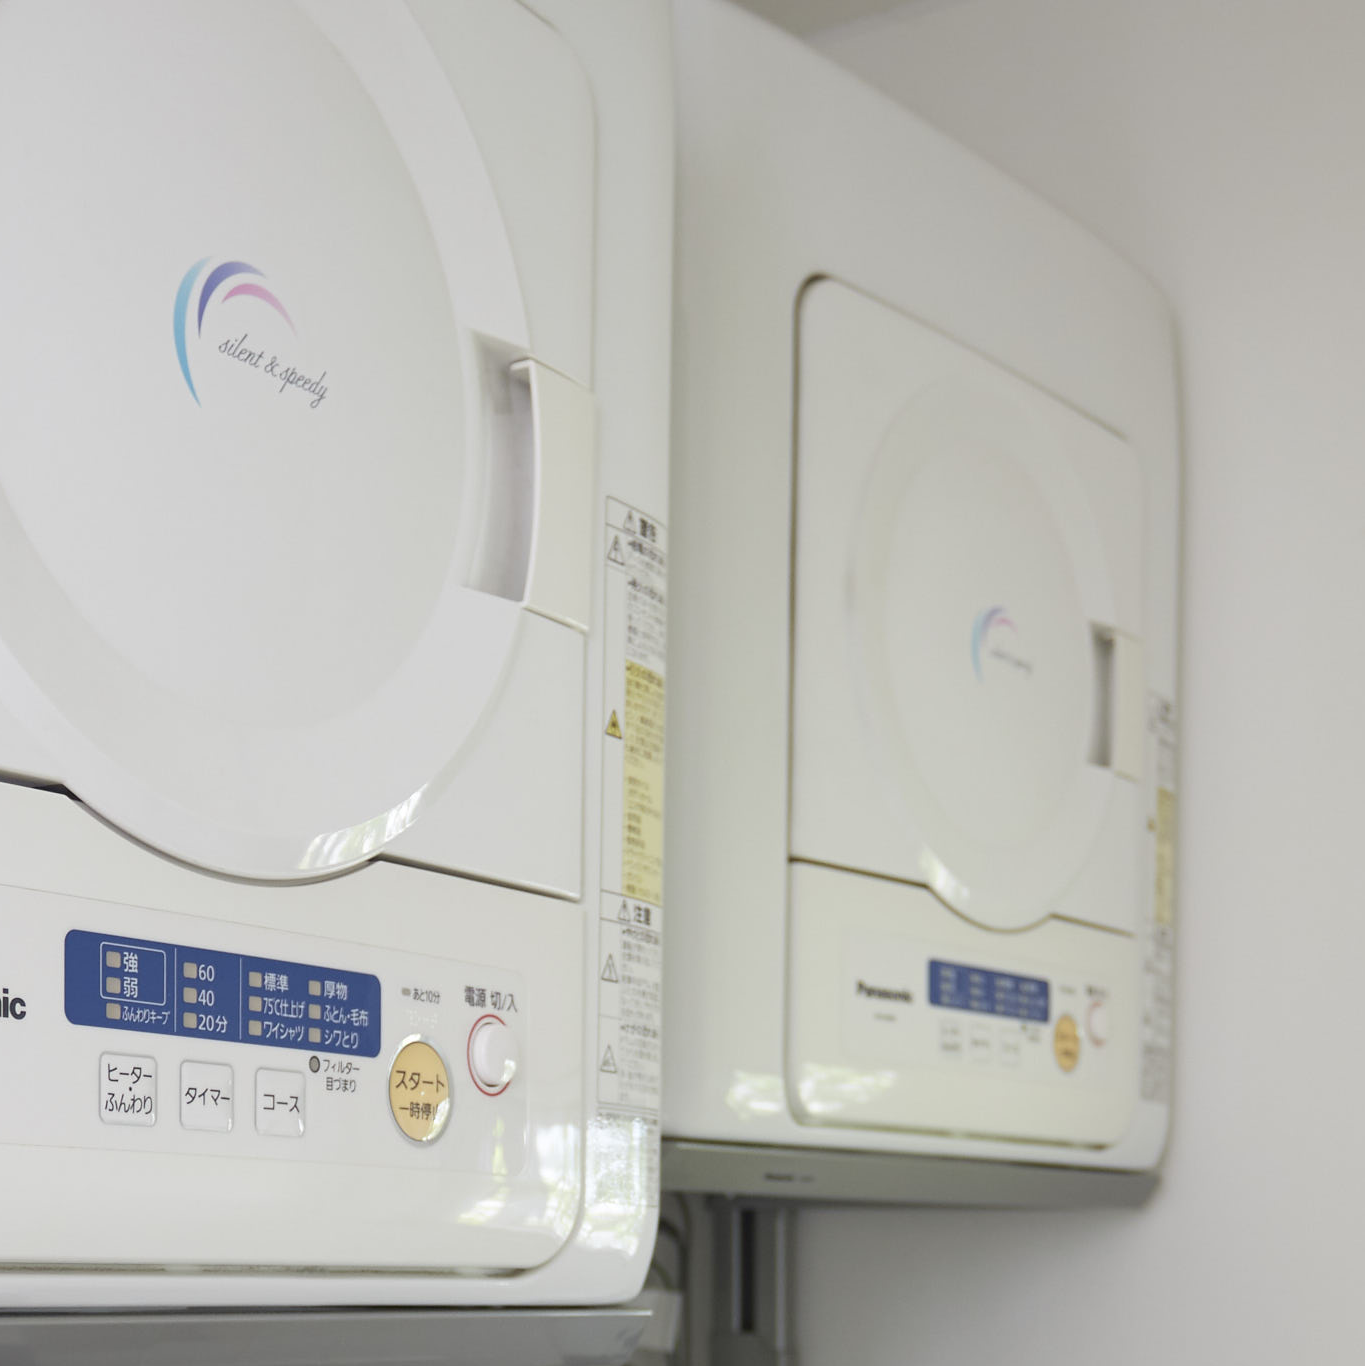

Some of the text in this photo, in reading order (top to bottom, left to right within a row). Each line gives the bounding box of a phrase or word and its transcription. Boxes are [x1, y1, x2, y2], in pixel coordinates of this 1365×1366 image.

[218, 333, 265, 368] silent
[279, 367, 328, 409] speedy
[123, 952, 138, 973] 強
[198, 964, 215, 982] 60
[264, 972, 289, 992] 標準
[123, 977, 138, 998] 弱
[324, 981, 348, 1000] 厚物
[198, 989, 215, 1007] 40
[122, 1005, 171, 1025] ふんわりキープ
[198, 1014, 228, 1033] 20分
[263, 1021, 304, 1041] ワイシャツ
[324, 1029, 359, 1049] シワとり
[107, 1064, 153, 1083] ヒーター
[323, 1059, 360, 1073] フィルター
[326, 1076, 356, 1092] 目づまり
[395, 1070, 445, 1093] スタート
[105, 1092, 153, 1115] ふんわり
[185, 1087, 231, 1106] タイマー
[263, 1094, 300, 1113] コース
